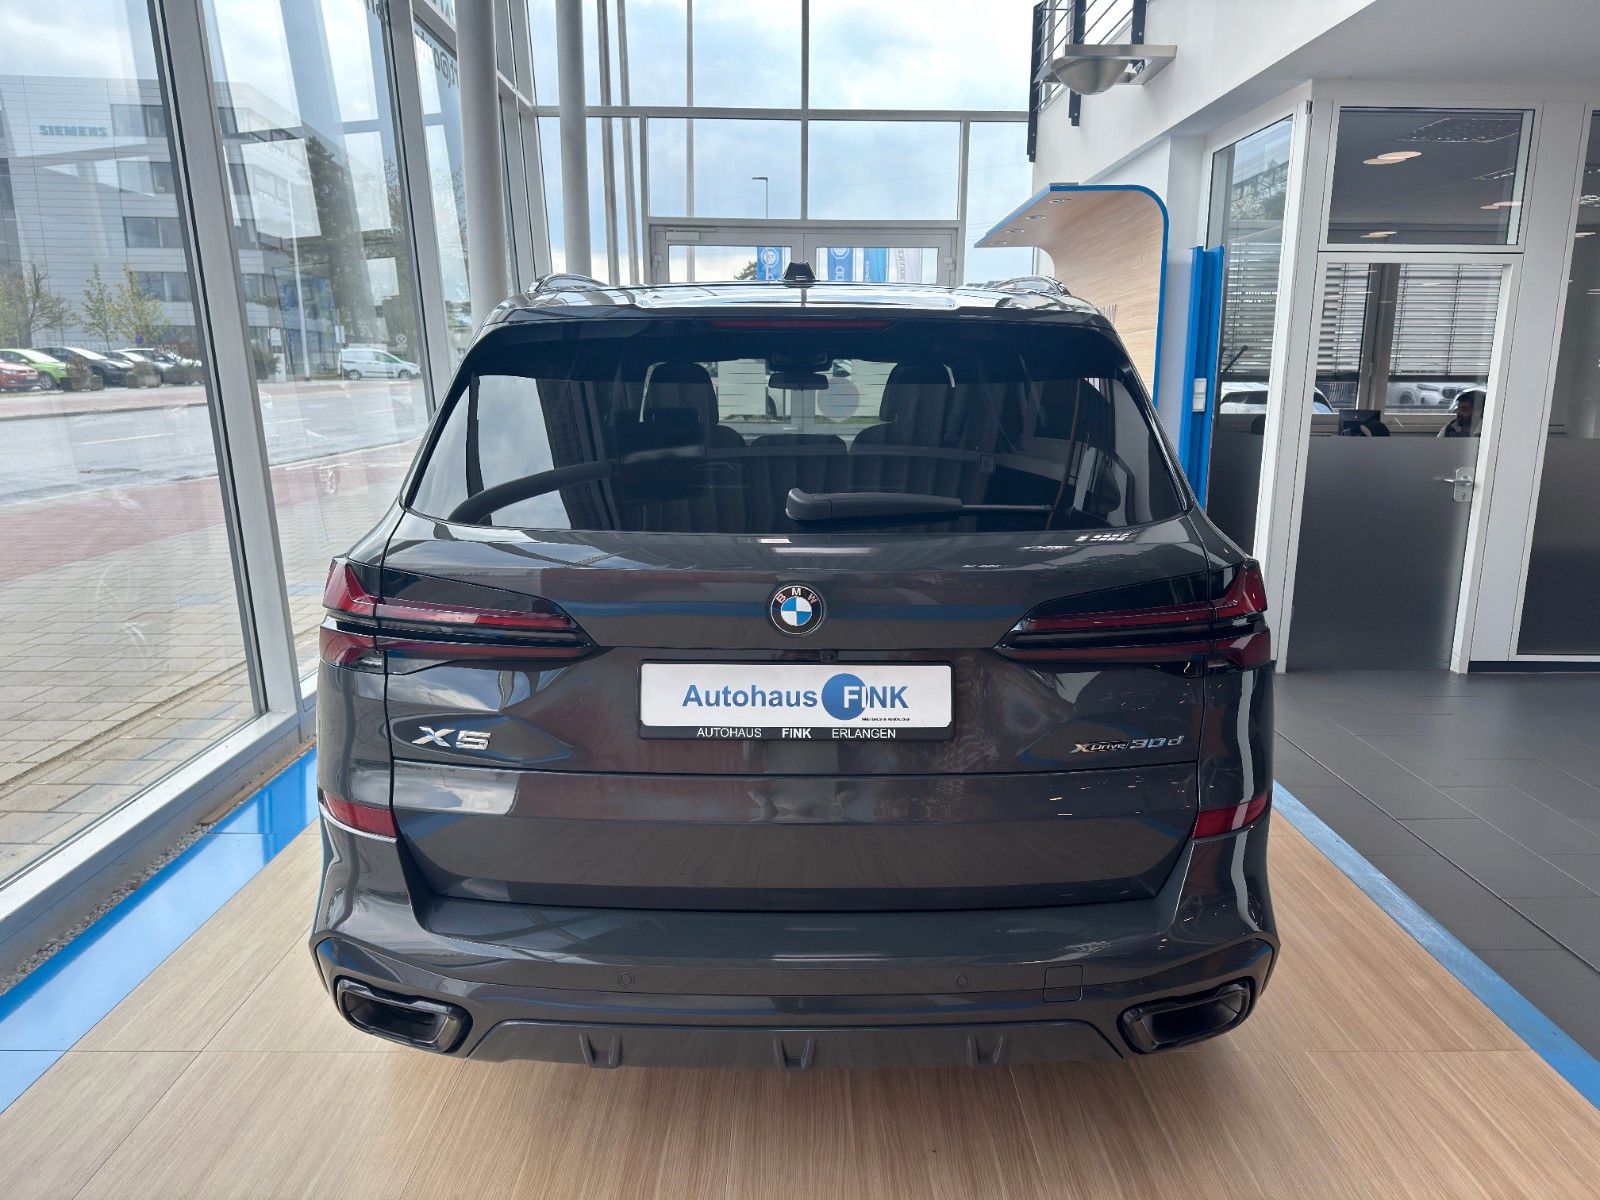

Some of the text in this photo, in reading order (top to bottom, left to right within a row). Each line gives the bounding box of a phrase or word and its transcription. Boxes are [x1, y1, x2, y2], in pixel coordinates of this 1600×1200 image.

[39, 125, 107, 137] SIEMENS
[776, 587, 817, 604] BMW
[682, 684, 910, 709] Autohaus FINK
[411, 726, 491, 751] X5
[697, 727, 896, 740] AUTOHAUS FINK ERLANGEN
